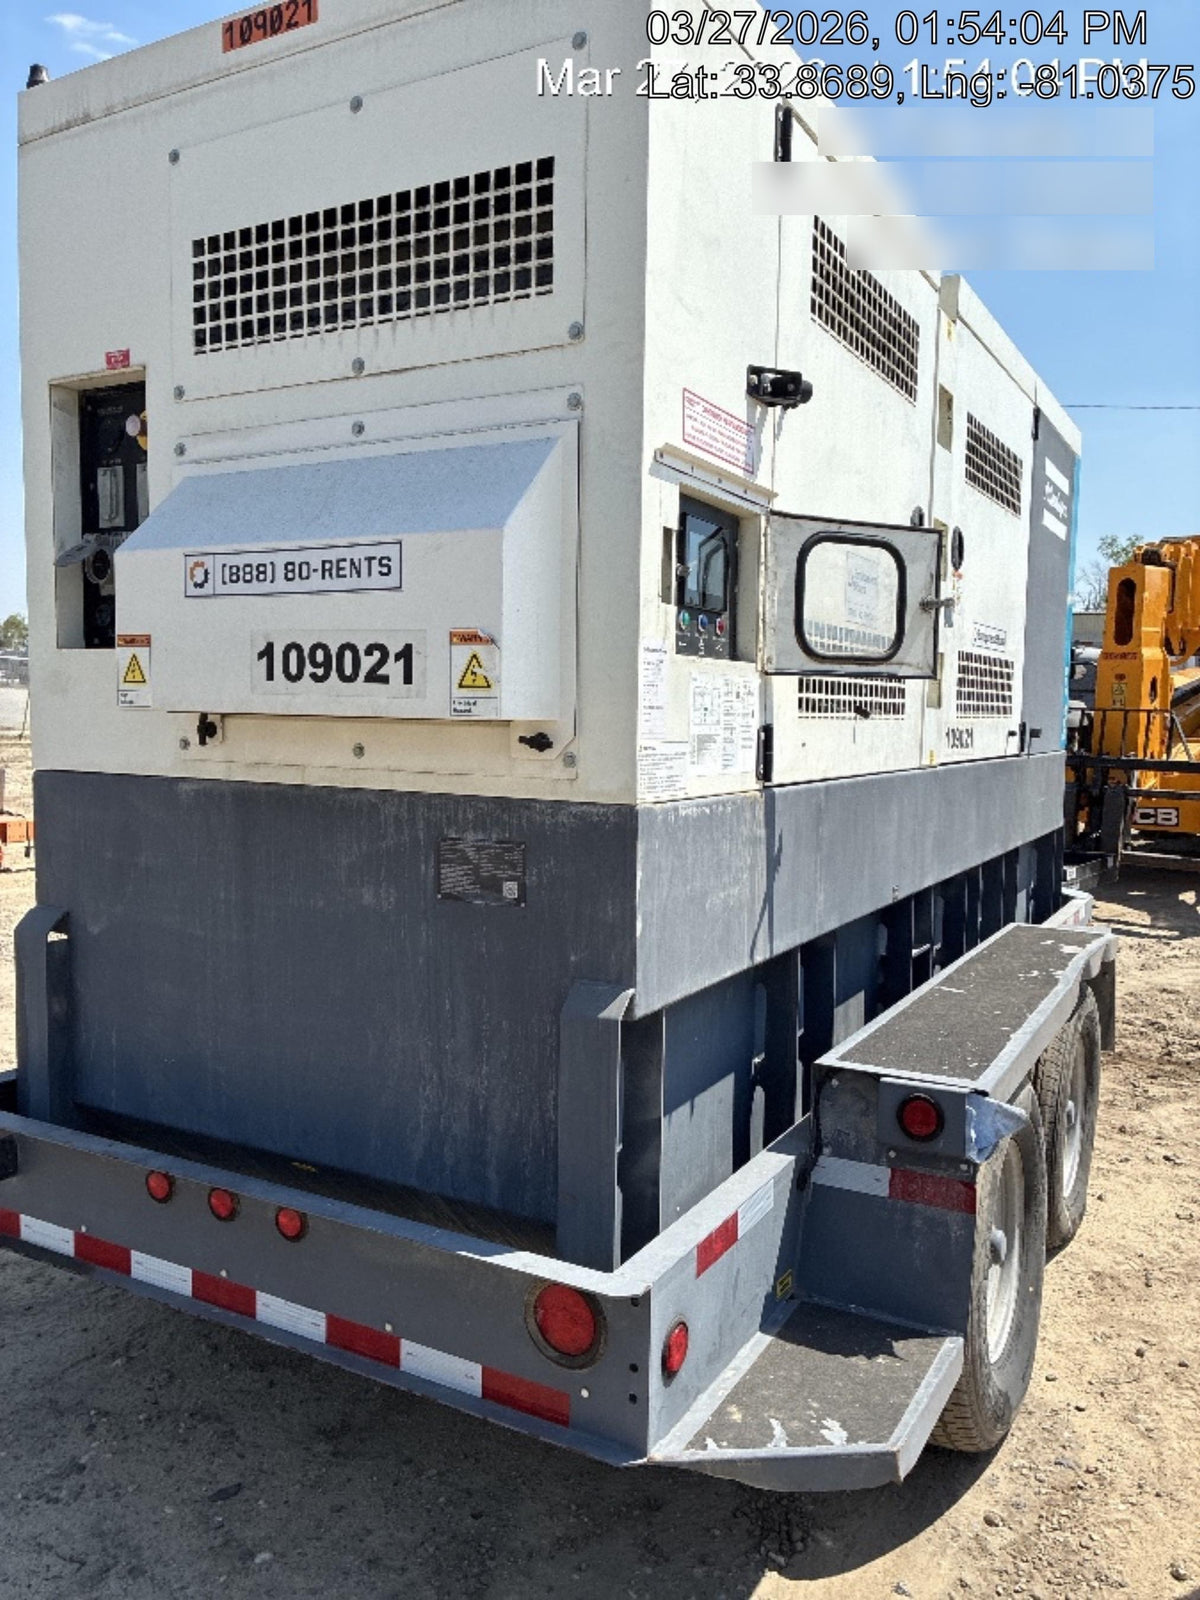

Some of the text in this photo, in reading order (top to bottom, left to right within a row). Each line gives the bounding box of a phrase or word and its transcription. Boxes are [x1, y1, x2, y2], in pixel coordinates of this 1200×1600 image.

[224, 0, 313, 49] 109021
[283, 556, 392, 582] 80-RENTS
[256, 641, 413, 685] 109021
[1132, 808, 1179, 826] CB
